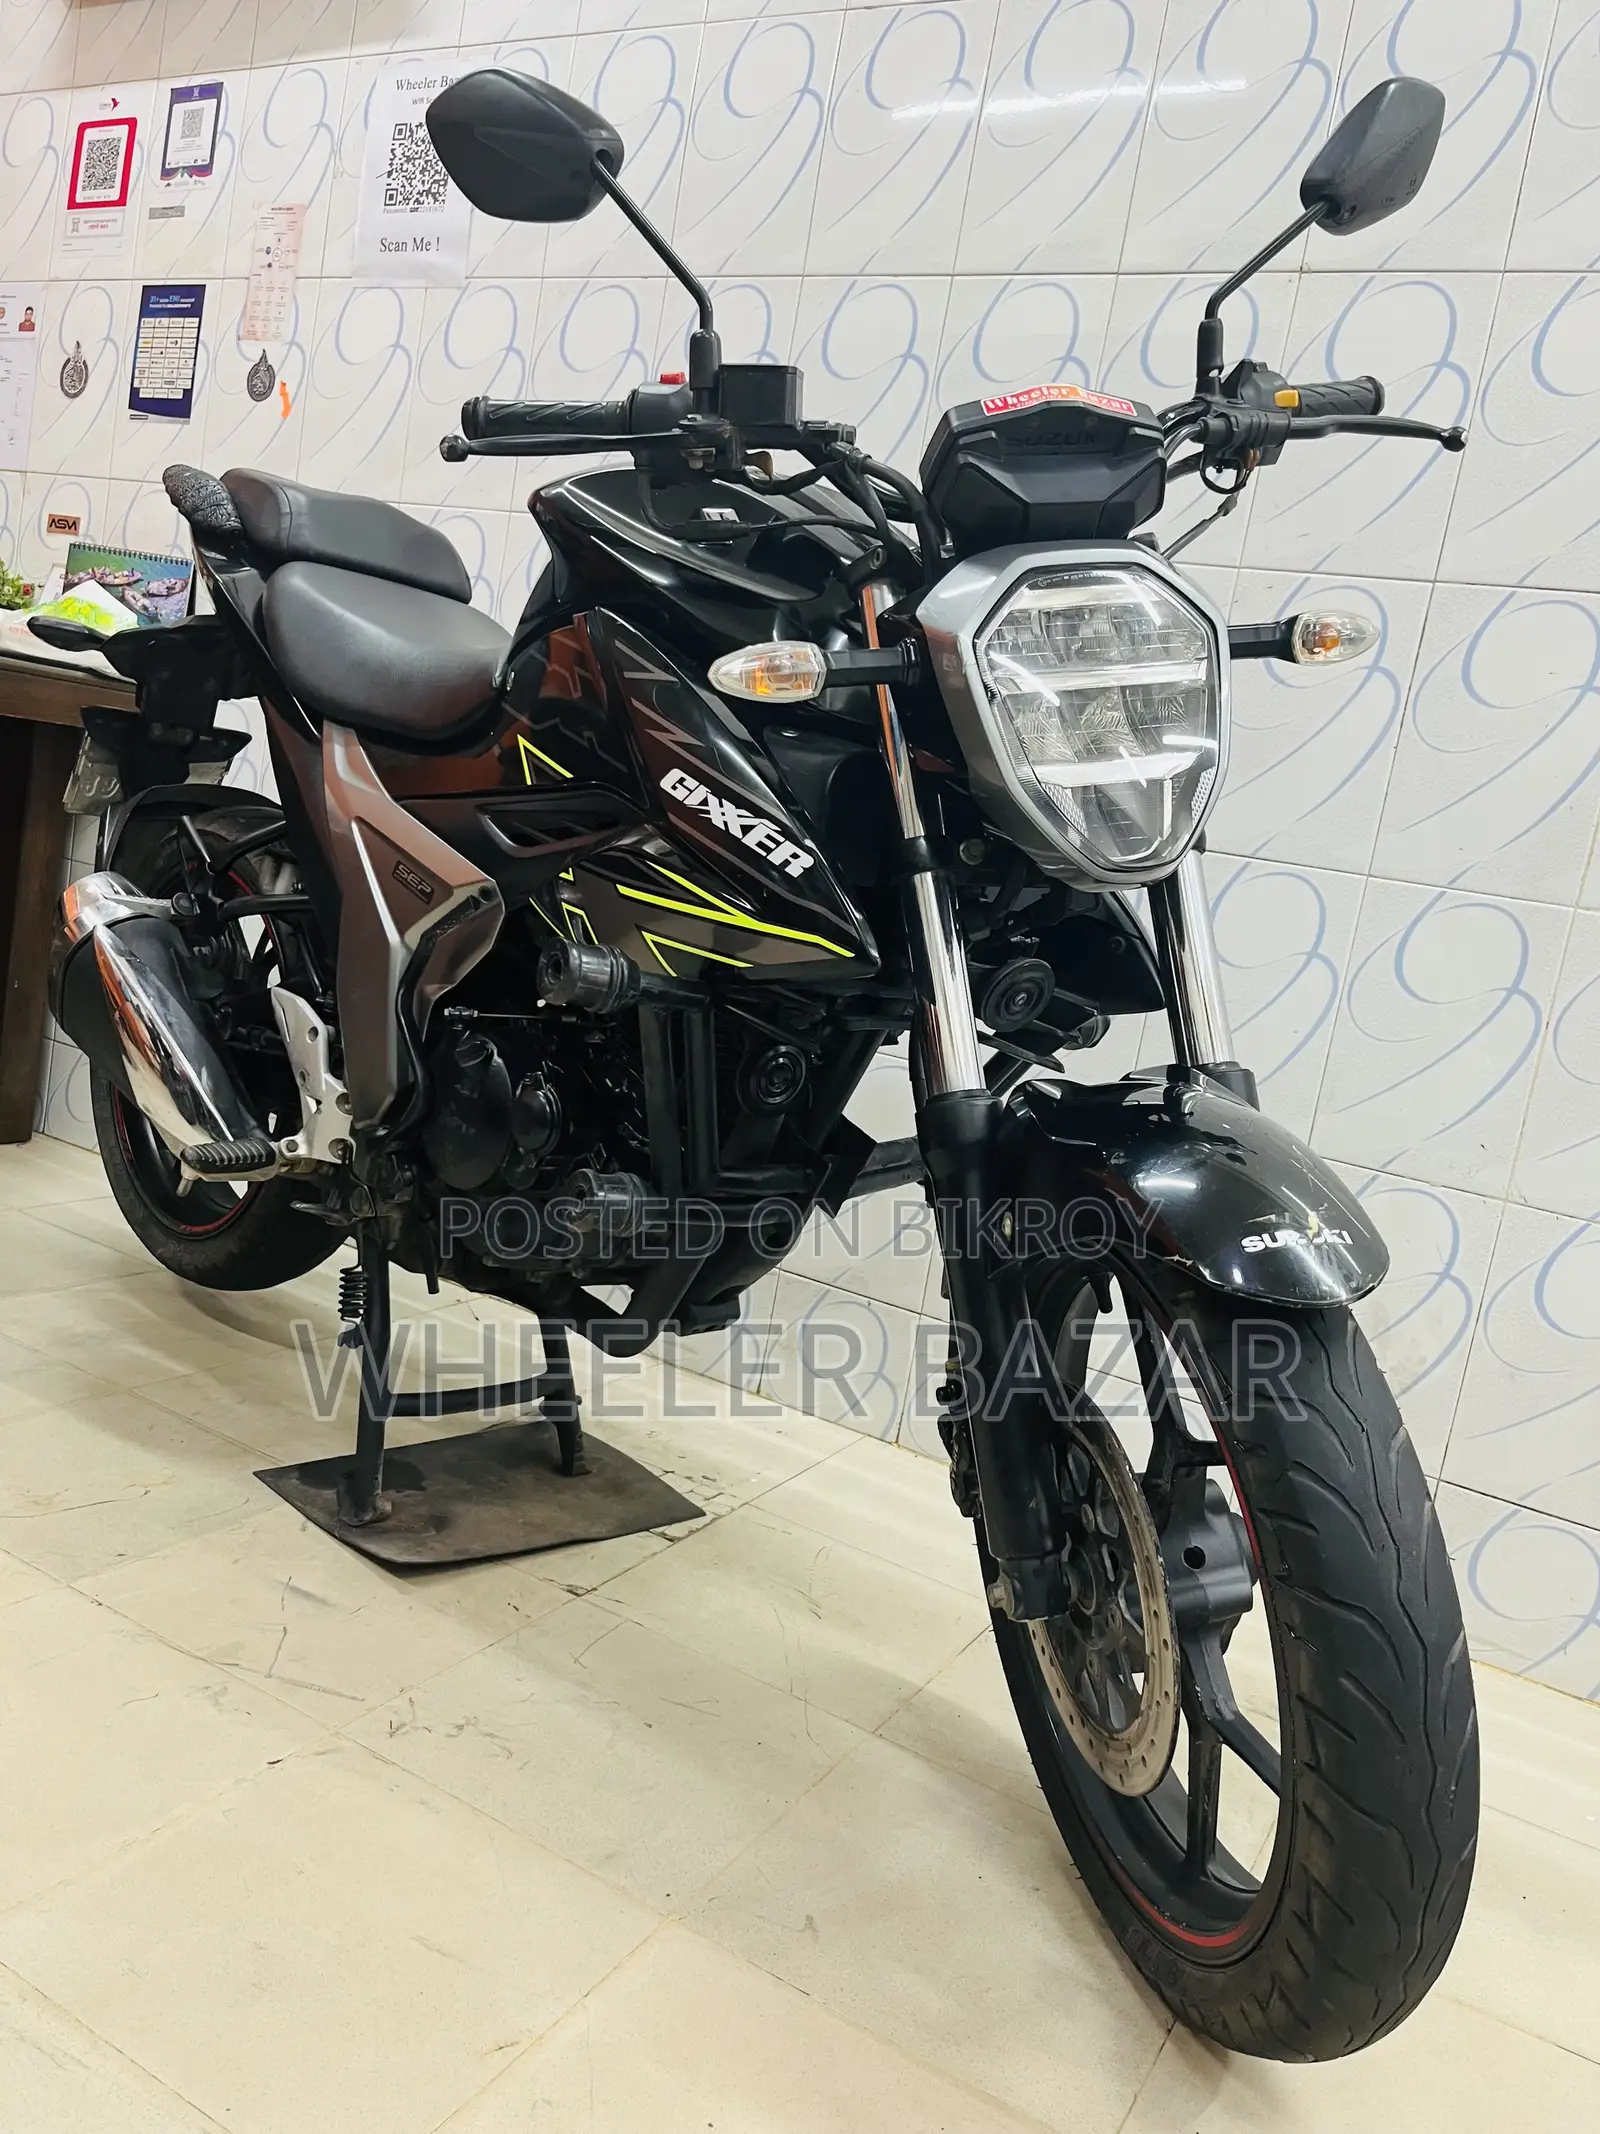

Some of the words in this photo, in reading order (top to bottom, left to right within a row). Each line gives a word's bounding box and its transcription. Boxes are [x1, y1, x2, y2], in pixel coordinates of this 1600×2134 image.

[396, 77, 438, 91] Wheeler
[440, 75, 461, 88] Ba
[379, 237, 408, 253] Scan
[412, 236, 432, 252] Me
[985, 386, 1071, 409] Wheeler
[1004, 428, 1105, 448] SUZUK
[659, 768, 815, 878] GIXXER
[395, 864, 432, 893] SEP
